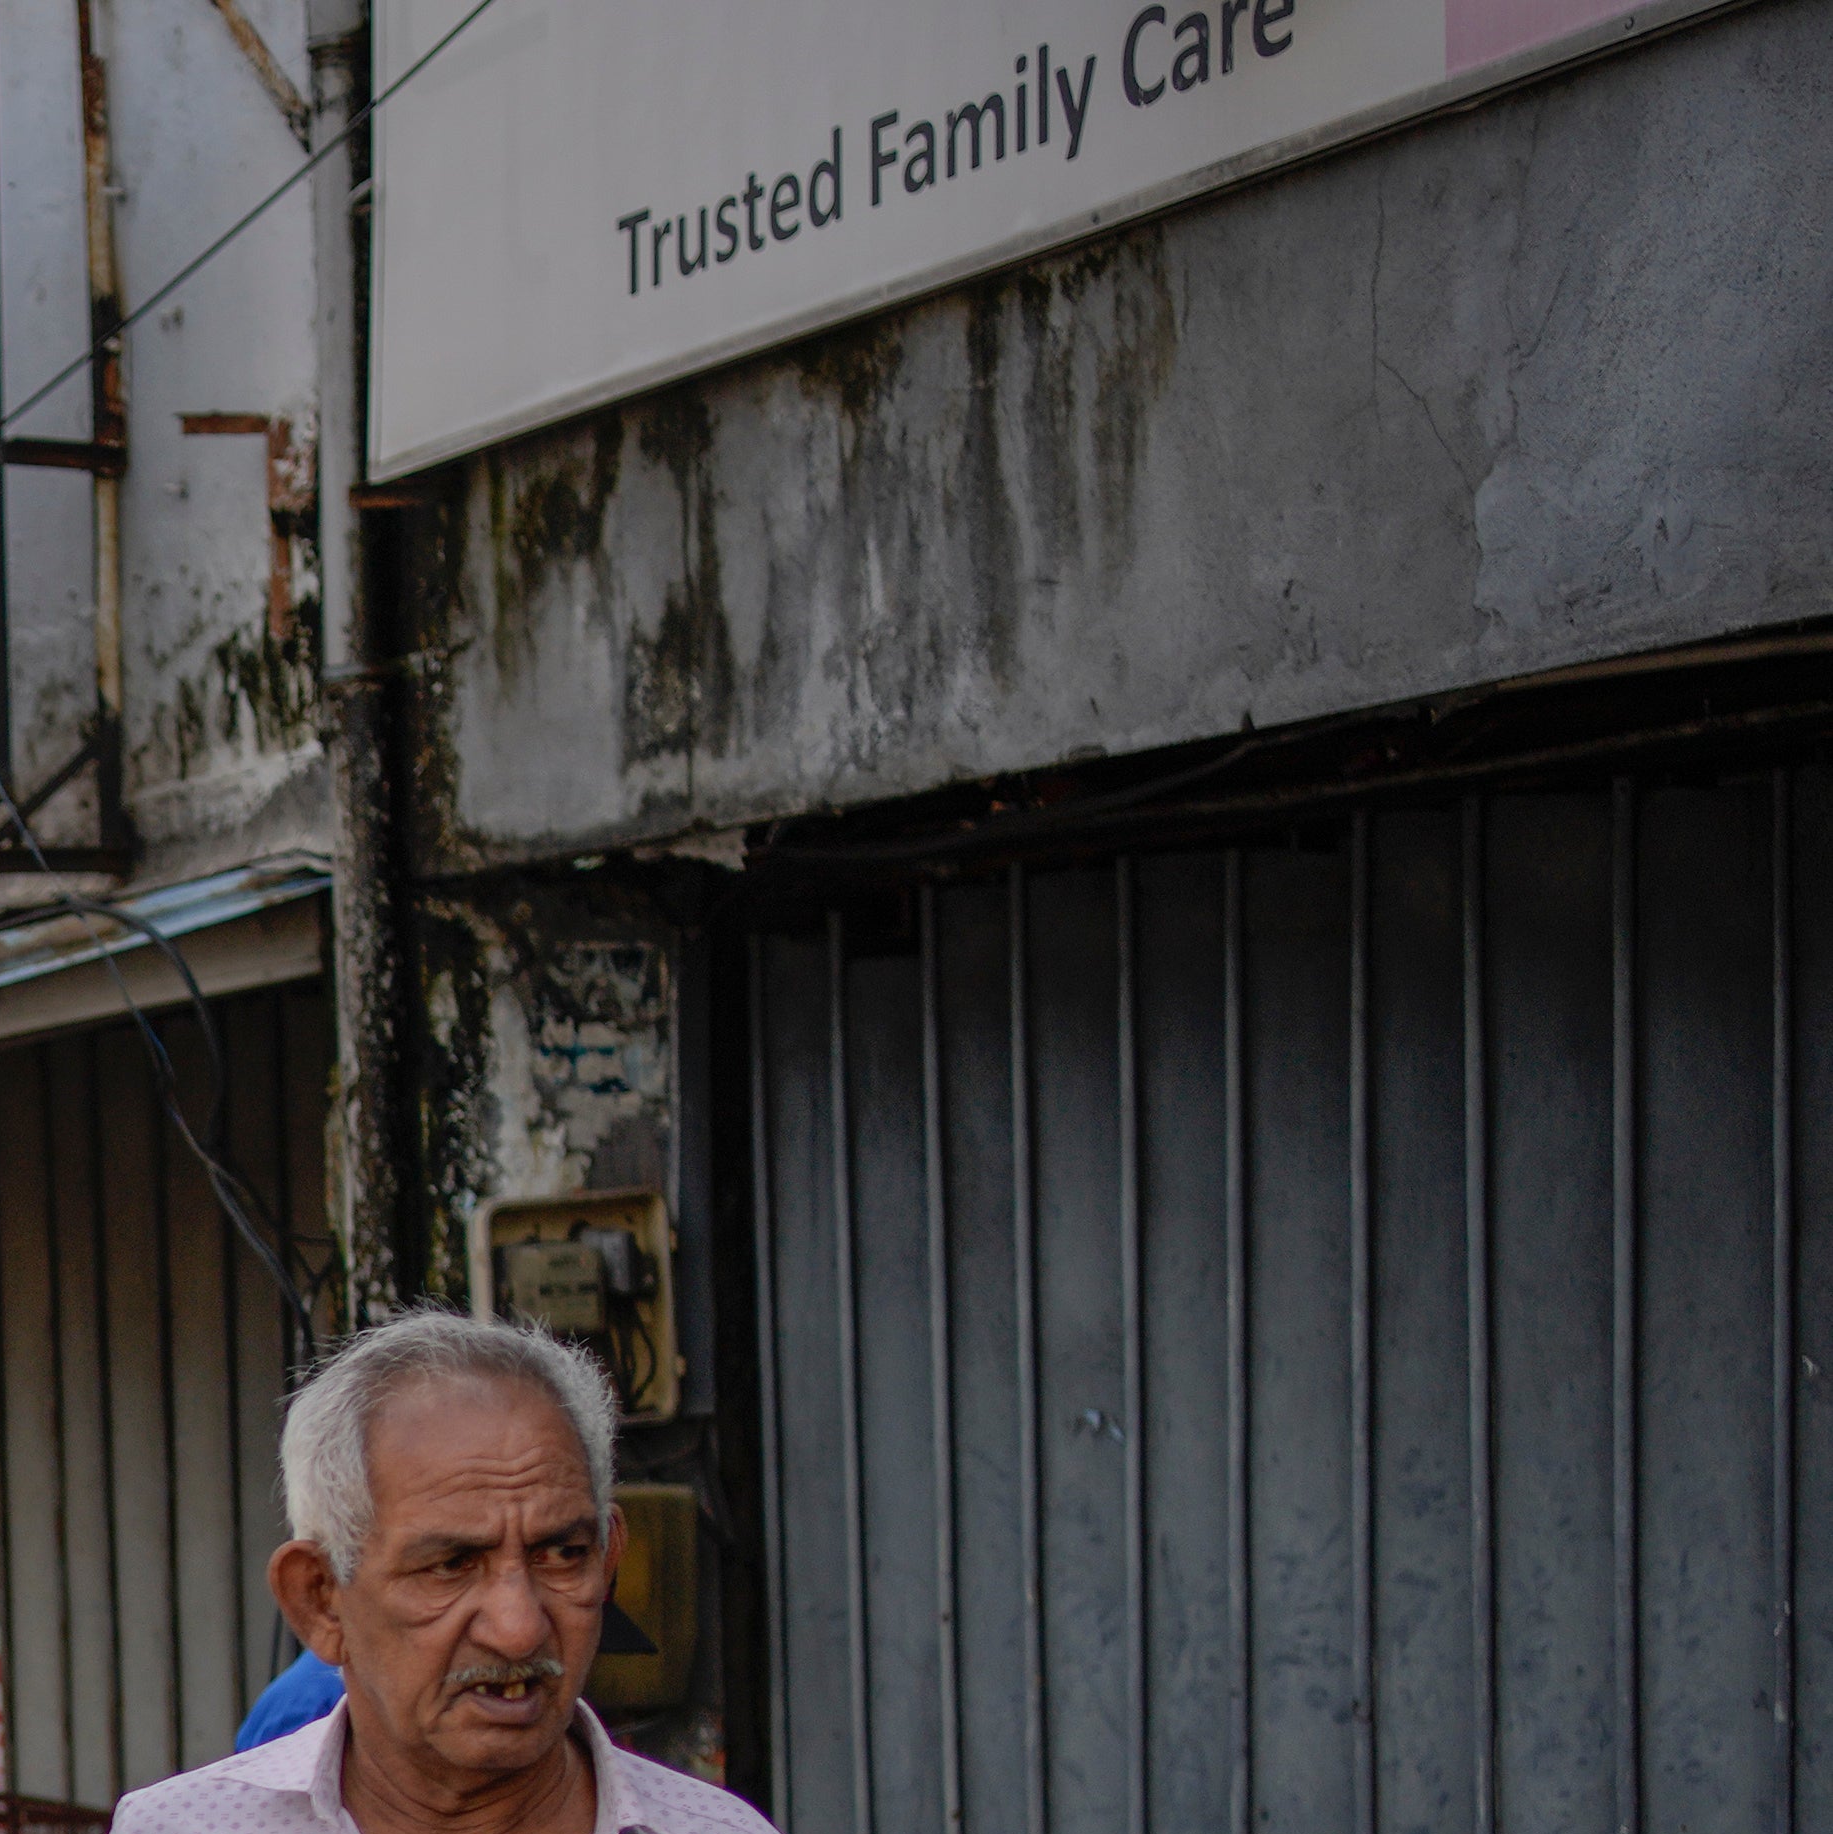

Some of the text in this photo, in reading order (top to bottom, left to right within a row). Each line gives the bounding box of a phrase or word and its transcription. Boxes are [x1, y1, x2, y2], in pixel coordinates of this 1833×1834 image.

[617, 0, 1297, 297] Trusted Family Care
